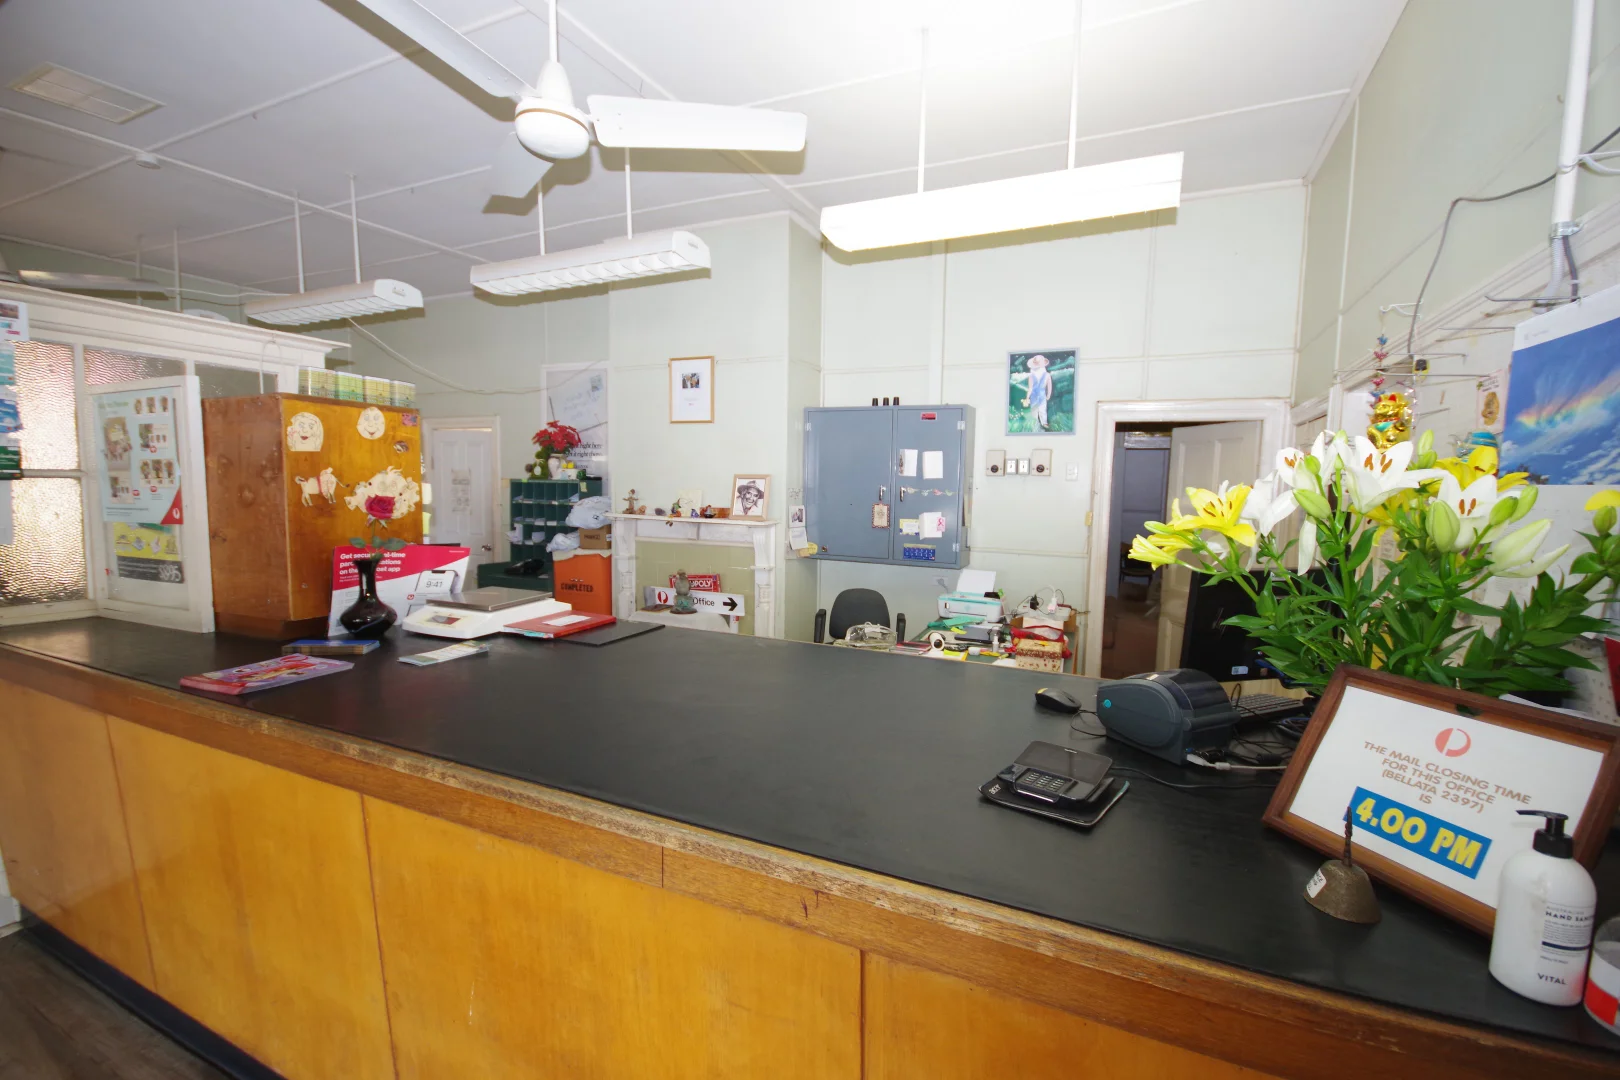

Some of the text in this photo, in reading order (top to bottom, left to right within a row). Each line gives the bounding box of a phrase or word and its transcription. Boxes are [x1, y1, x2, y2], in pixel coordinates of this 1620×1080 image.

[560, 582, 594, 592] COMPLETED
[693, 597, 715, 607] Office
[1364, 741, 1532, 805] THE MAIL CLOSING TIME
[1381, 758, 1496, 804] FOR THIS OFFICE
[1381, 769, 1485, 814] (BELLATA 2397)
[1419, 793, 1433, 805] IS
[1356, 797, 1483, 869] 4.00 PM
[1545, 911, 1573, 921] HAND
[1537, 972, 1568, 985] VITAL
